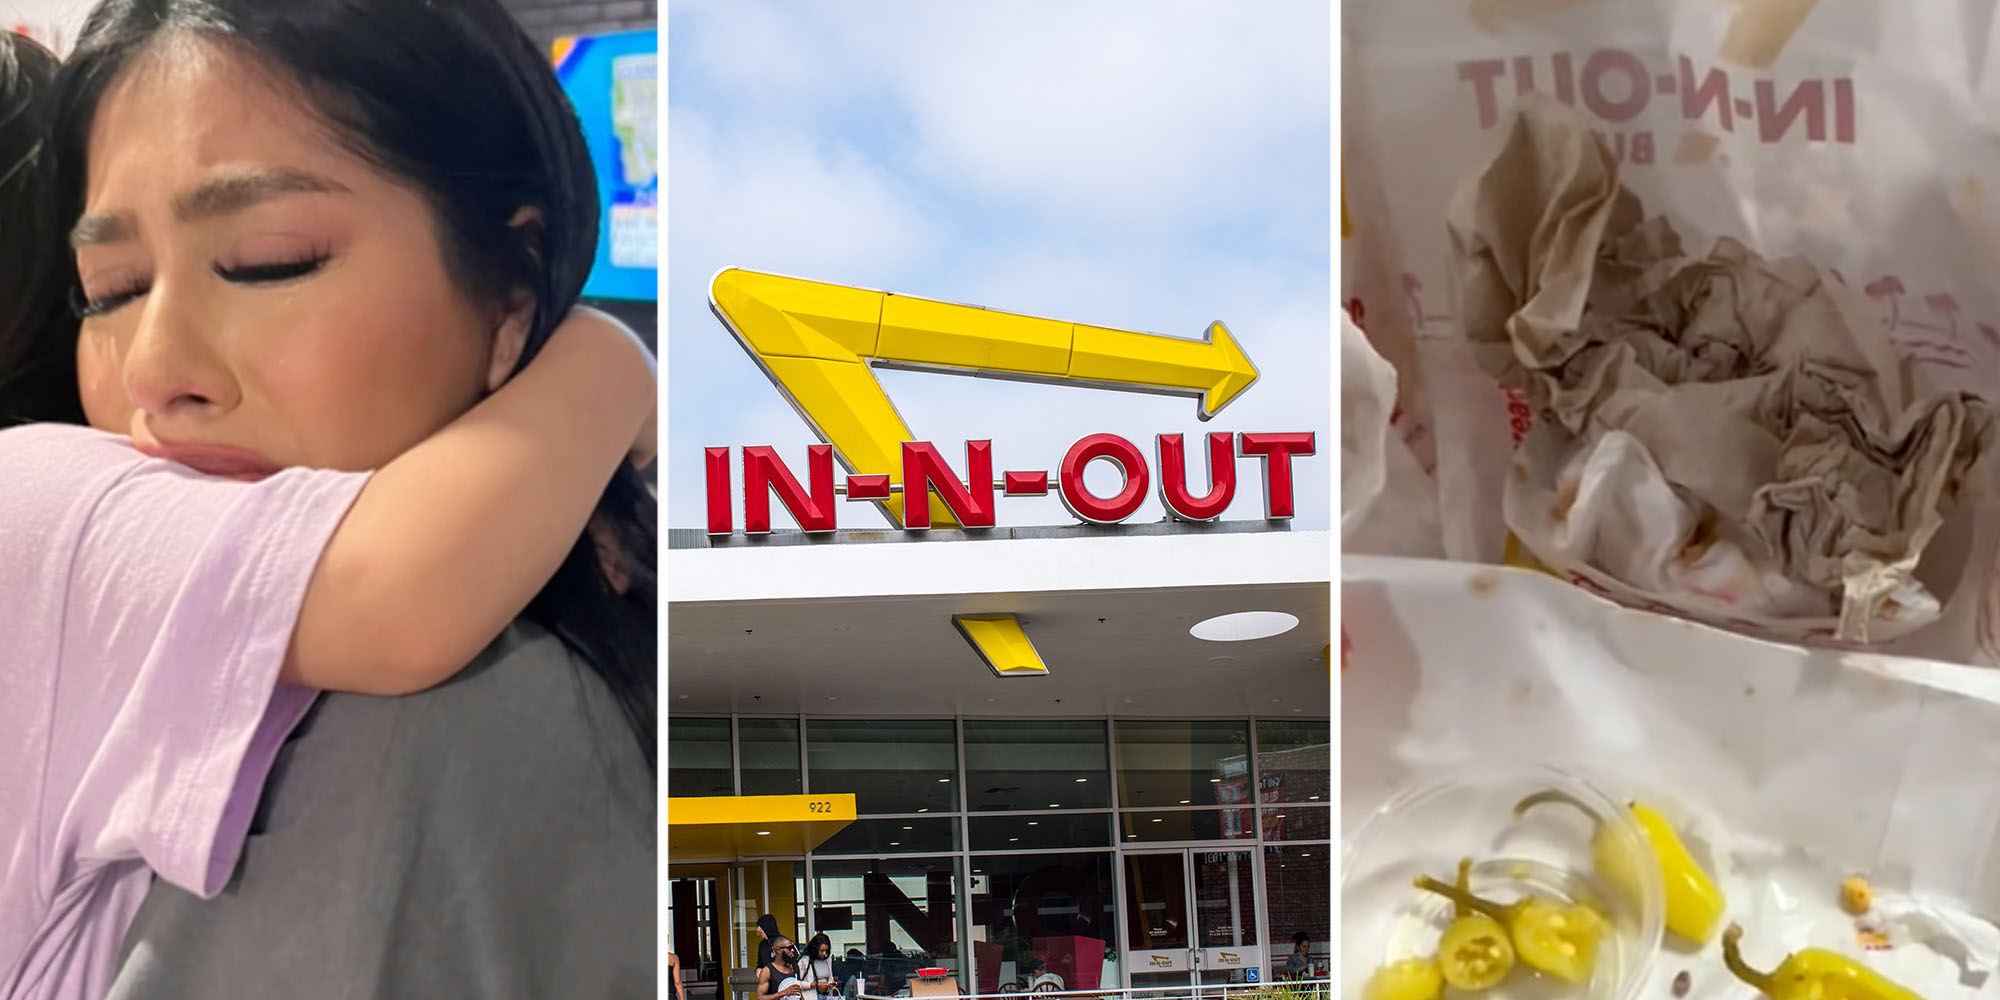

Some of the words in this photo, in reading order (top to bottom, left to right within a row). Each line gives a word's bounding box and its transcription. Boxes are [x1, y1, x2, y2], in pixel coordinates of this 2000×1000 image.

[704, 431, 1317, 536] IN-N-OUT
[809, 801, 832, 813] 922
[1149, 959, 1172, 967] IN-N-OUT
